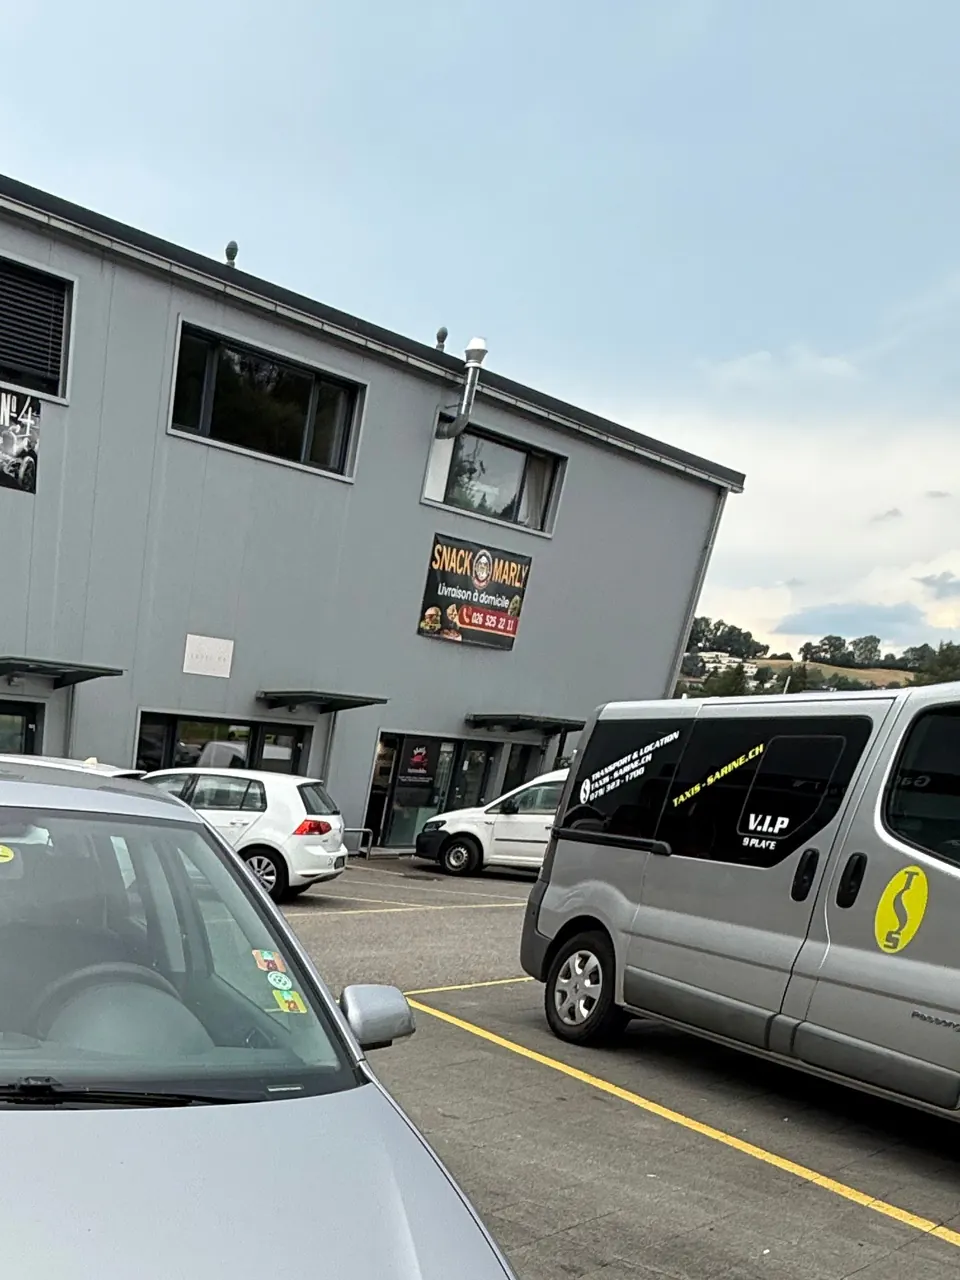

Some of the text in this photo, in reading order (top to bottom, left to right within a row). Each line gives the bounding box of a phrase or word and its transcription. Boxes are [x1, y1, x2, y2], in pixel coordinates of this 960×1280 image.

[431, 543, 529, 588] SNACK MARLY
[437, 582, 510, 609] Livraison à domicile
[471, 611, 483, 625] 026
[485, 614, 497, 628] 525
[591, 730, 680, 781] TRANSPORT & LOCATION
[625, 766, 645, 783] 1700
[673, 783, 701, 807] TAXIS
[707, 743, 764, 786] SARINE.CH
[748, 813, 790, 834] V.I.P
[742, 837, 750, 847] 9
